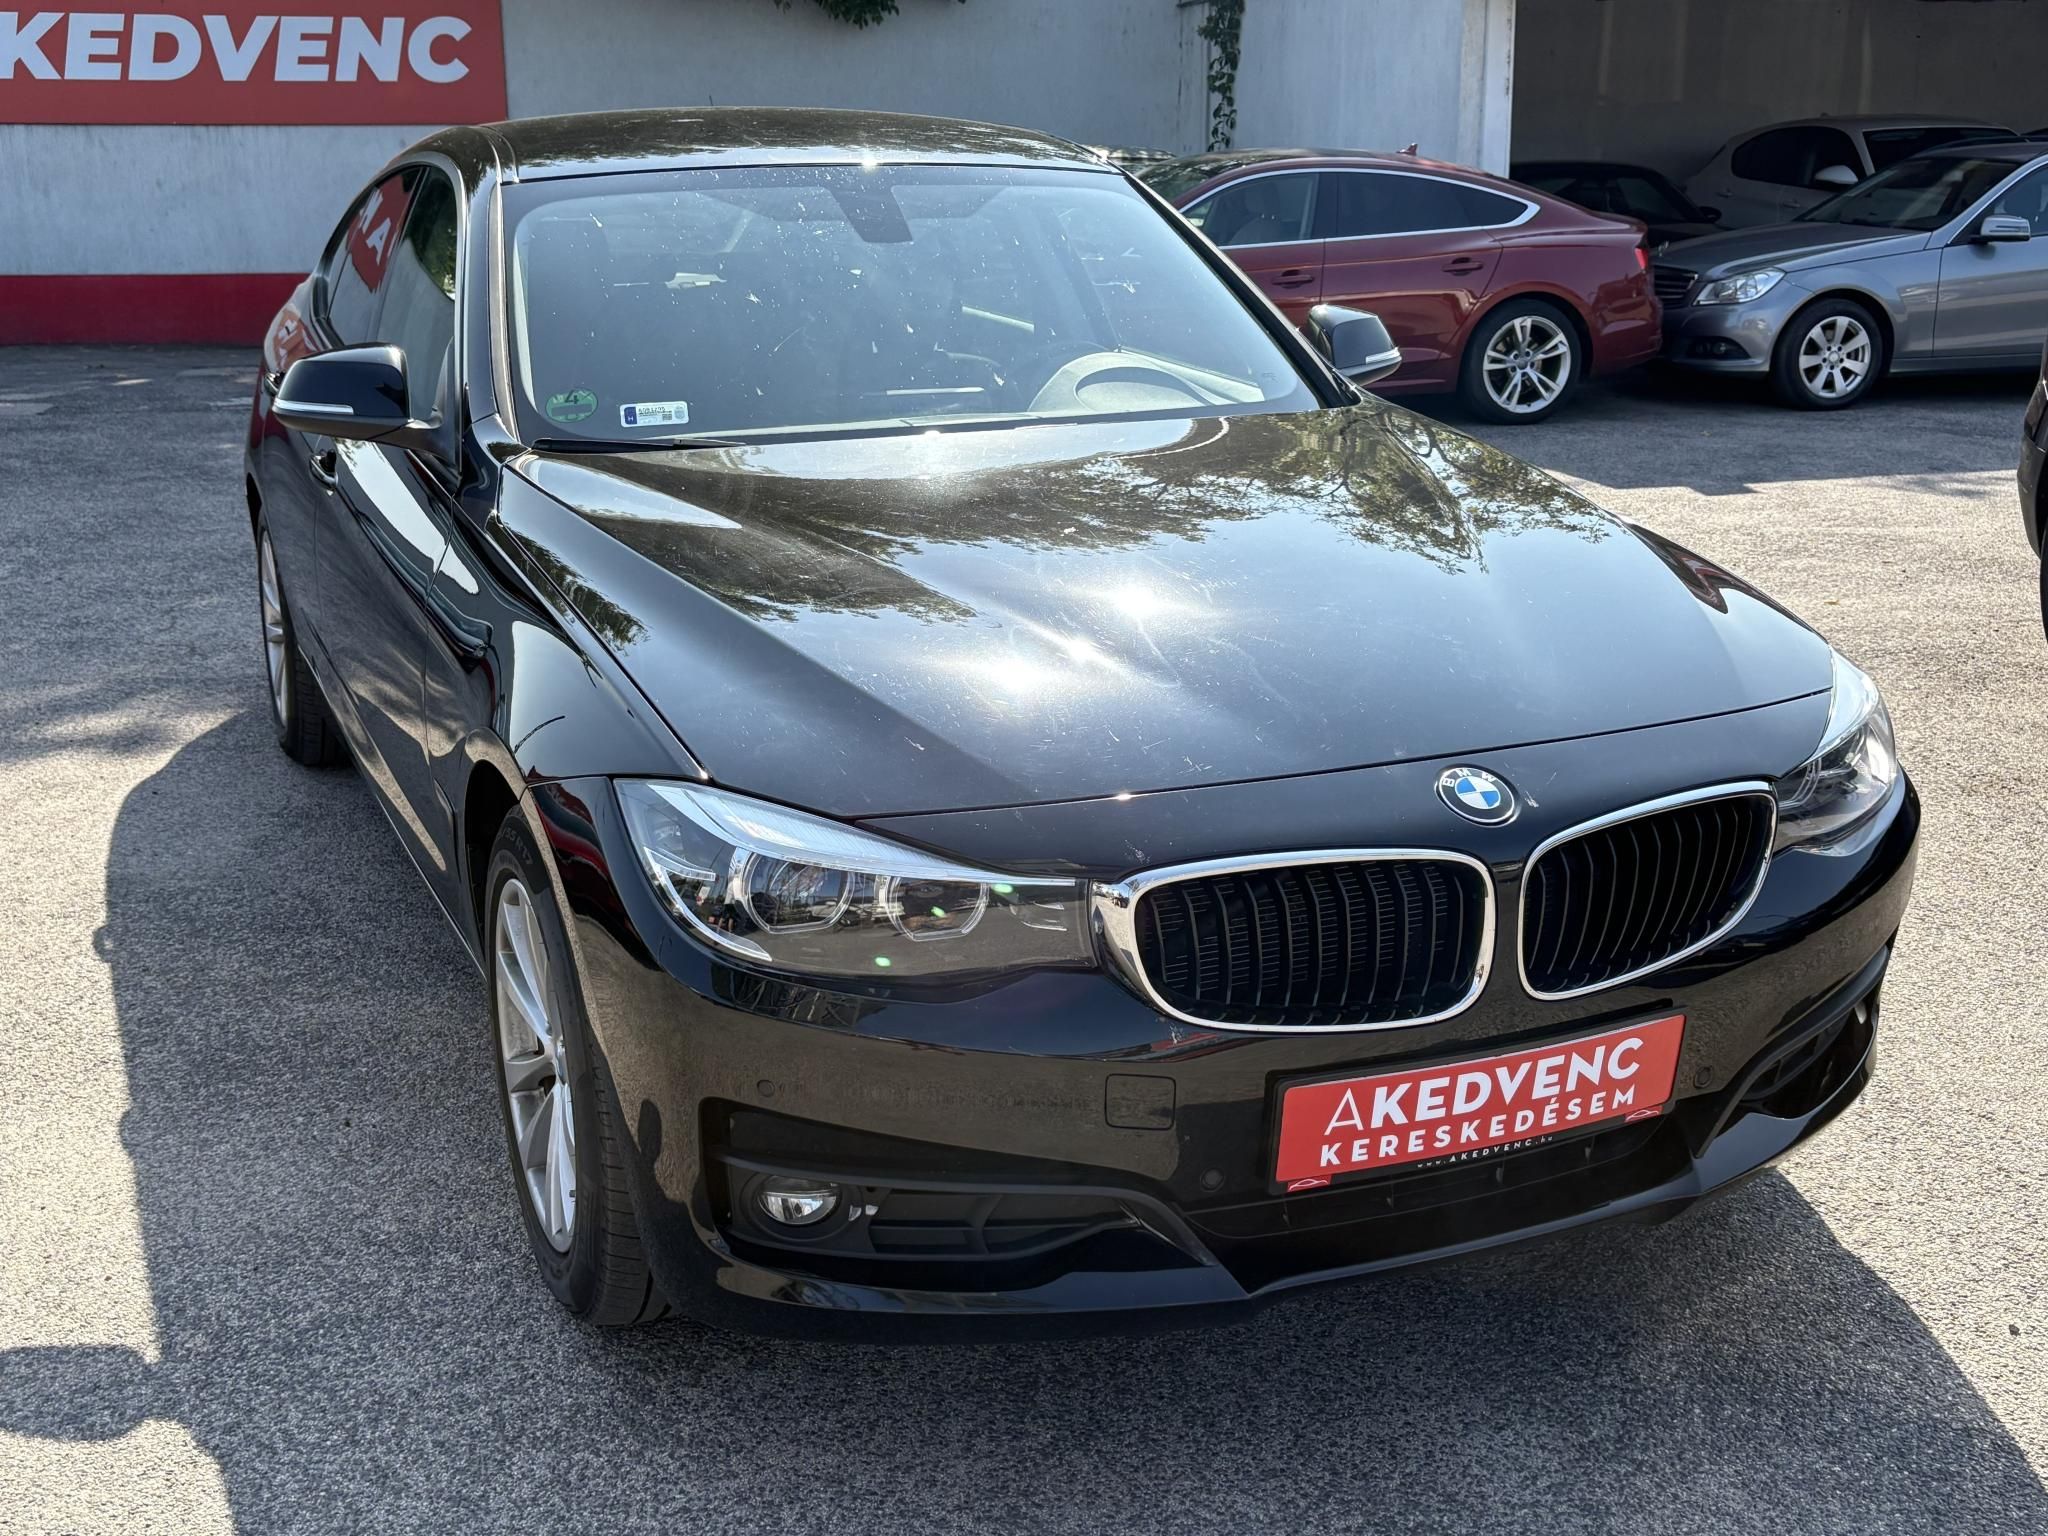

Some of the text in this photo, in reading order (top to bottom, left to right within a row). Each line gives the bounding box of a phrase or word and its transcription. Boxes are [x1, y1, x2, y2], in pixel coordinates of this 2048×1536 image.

[0, 11, 472, 83] KEDVENC
[1442, 767, 1498, 788] BMW
[1320, 1085, 1635, 1167] KERESKEDÉSEM
[1416, 1136, 1554, 1168] www.AKEDVENC.hu
